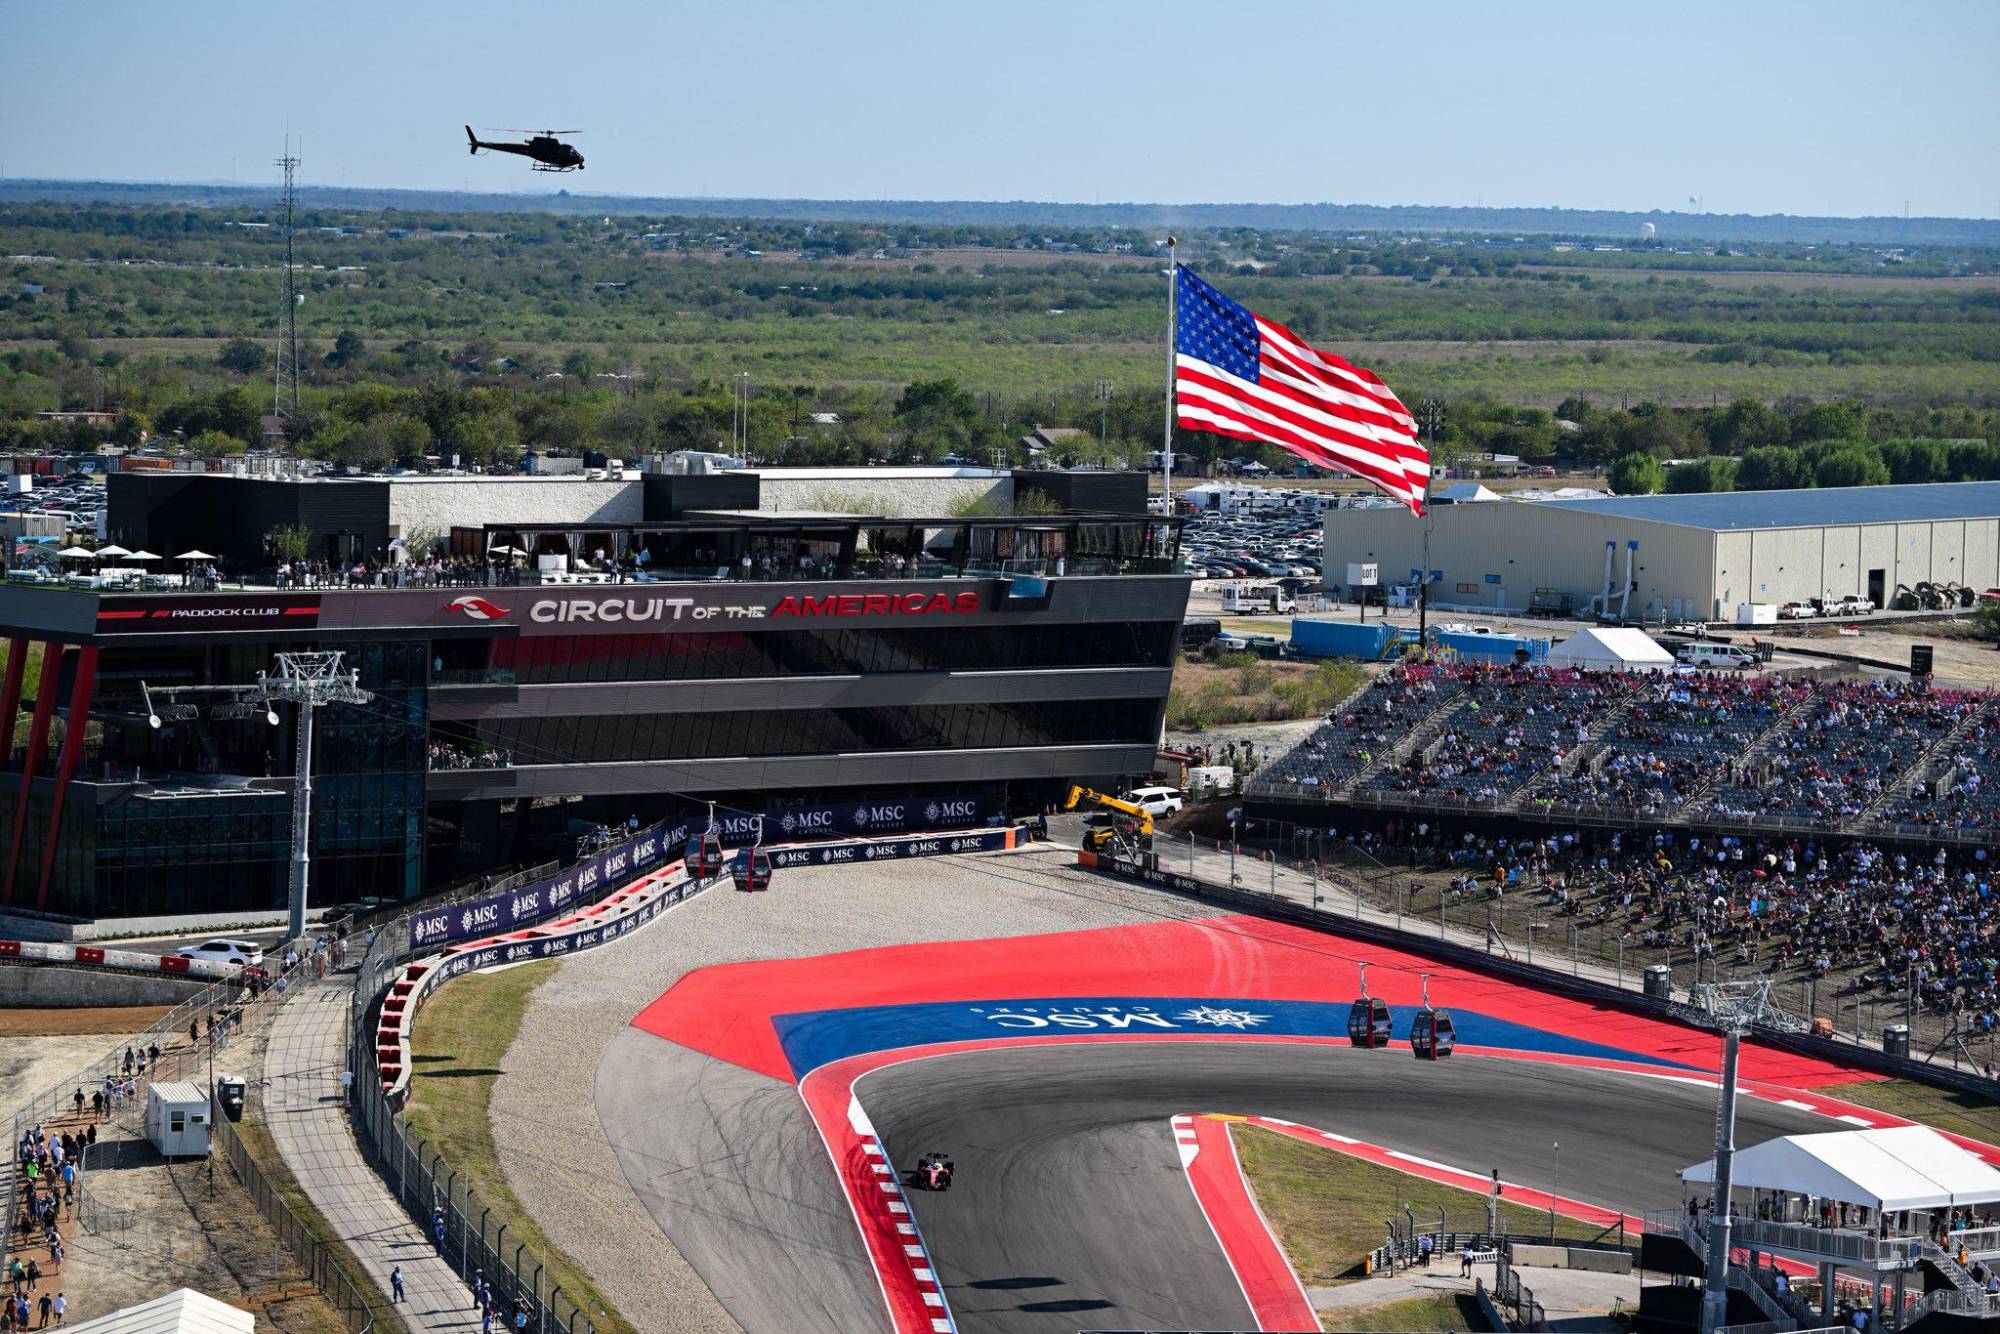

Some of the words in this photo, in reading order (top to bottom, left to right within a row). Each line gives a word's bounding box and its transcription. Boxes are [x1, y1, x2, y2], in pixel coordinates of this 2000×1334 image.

[1363, 569, 1372, 578] LOT
[172, 609, 241, 617] PADDOCK
[243, 608, 280, 616] CLUB
[530, 599, 694, 622] CIRCUIT
[692, 608, 721, 619] OF
[725, 606, 766, 618] THE
[771, 592, 981, 616] AMERICAS
[871, 805, 904, 822] MSC
[942, 801, 975, 818] MSC
[725, 817, 760, 833] MSC
[799, 811, 832, 827] MSC
[671, 825, 687, 845] MSC
[641, 839, 655, 857] MSC
[920, 842, 939, 851] MSC
[962, 838, 982, 847] MSC
[788, 852, 810, 862] MSC
[833, 849, 854, 859] MSC
[876, 846, 896, 855] MSC
[611, 852, 626, 871] MSC
[584, 865, 598, 885] MSC
[1121, 863, 1137, 875] MSC
[1151, 871, 1166, 882] MSC
[1182, 880, 1197, 890] MSC
[521, 892, 539, 911] MSC
[474, 904, 498, 924] MSC
[425, 915, 448, 935] MSC
[552, 939, 569, 951] MSC
[583, 932, 597, 945] MSC
[481, 950, 498, 961] MSC
[515, 944, 533, 956] MSC
[987, 1013, 1182, 1028] MSC
